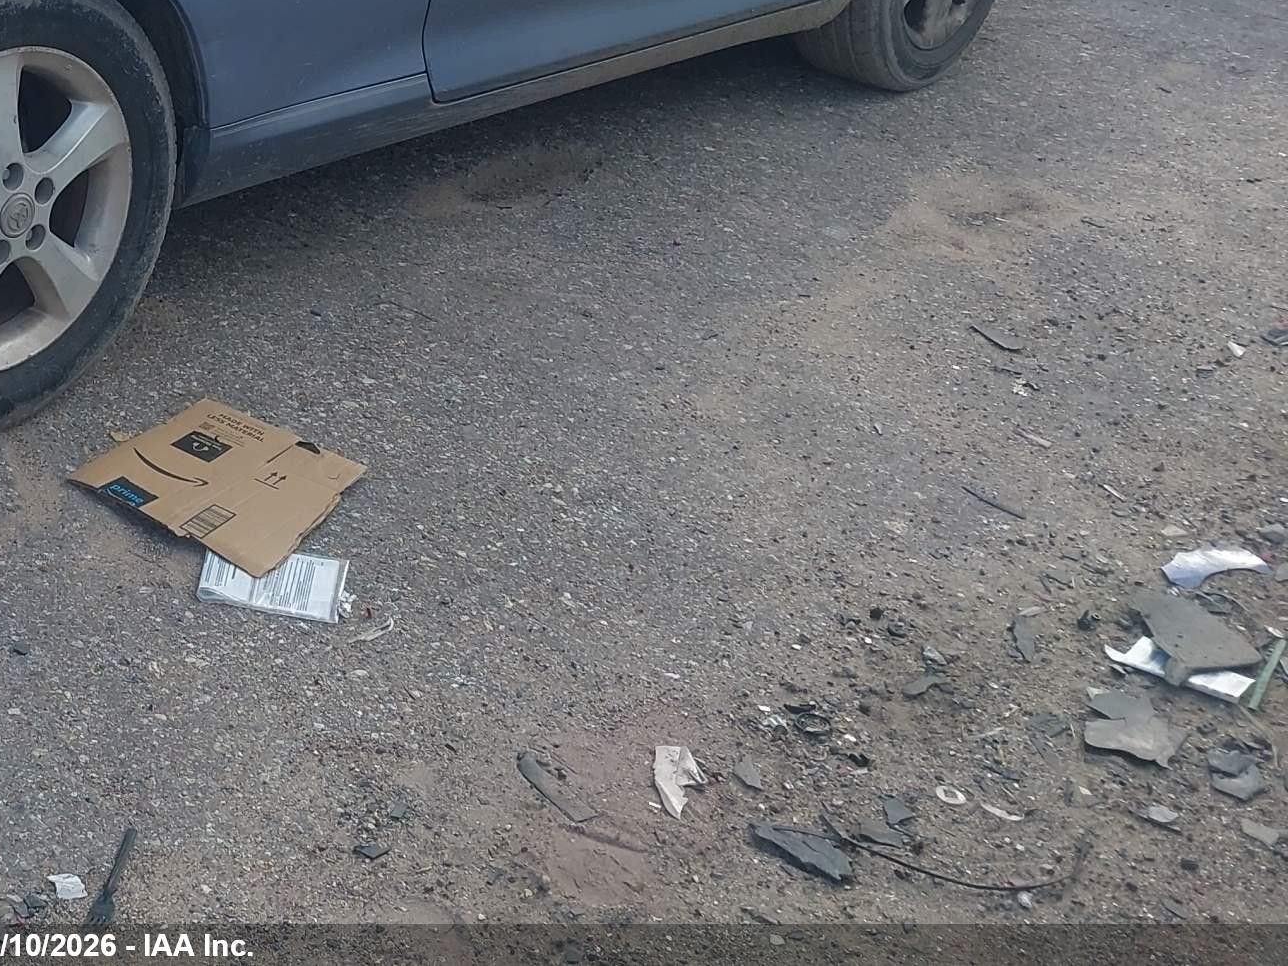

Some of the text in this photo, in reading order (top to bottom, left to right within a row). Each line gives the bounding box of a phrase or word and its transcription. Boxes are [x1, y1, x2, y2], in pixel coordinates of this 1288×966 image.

[206, 414, 225, 425] LESS
[225, 422, 265, 443] MATERIAL
[218, 413, 265, 436] MADE WITH
[109, 484, 144, 504] prime
